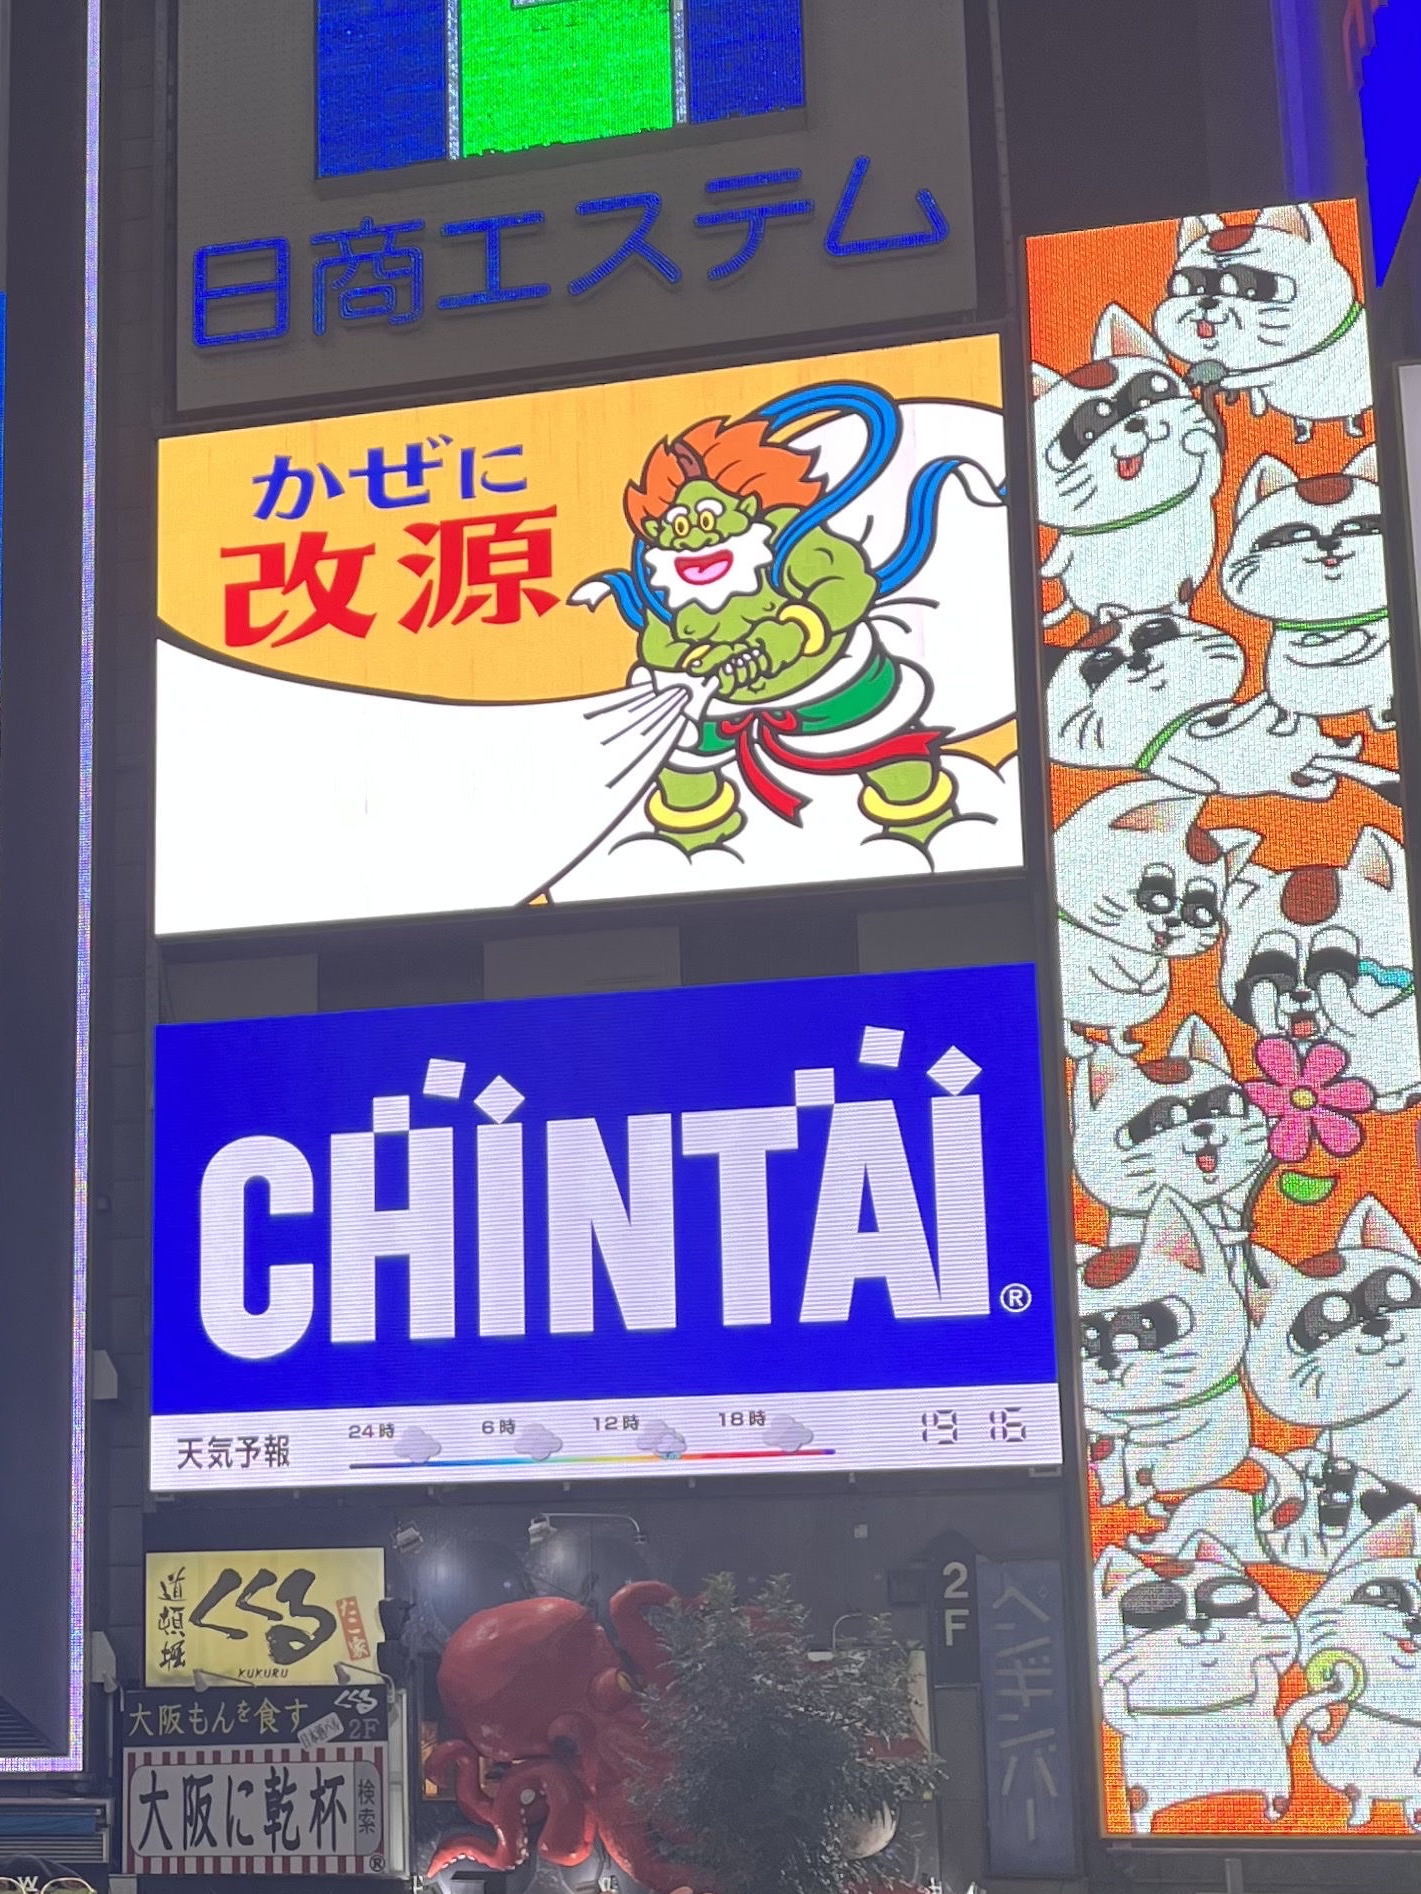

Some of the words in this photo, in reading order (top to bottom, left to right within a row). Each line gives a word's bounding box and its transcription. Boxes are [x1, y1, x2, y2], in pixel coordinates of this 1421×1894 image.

[192, 155, 950, 348] 日商エステム
[251, 434, 529, 521] かぜに
[220, 505, 561, 649] 改源
[349, 1422, 395, 1439] 24時
[482, 1419, 516, 1435] 6時
[592, 1414, 640, 1432] 12時
[719, 1410, 767, 1428] 18時
[177, 1434, 291, 1471] 天気予報
[158, 1566, 187, 1671] 道頓堀
[189, 1568, 337, 1666] くくる
[238, 1668, 289, 1679] KUKURU
[129, 1697, 308, 1737] 大阪もんを食す
[348, 1718, 380, 1740] 2F
[992, 1587, 1059, 1842] ペンギンバー
[138, 1766, 348, 1853] 大阪に乾杯
[357, 1778, 376, 1834] 検索
